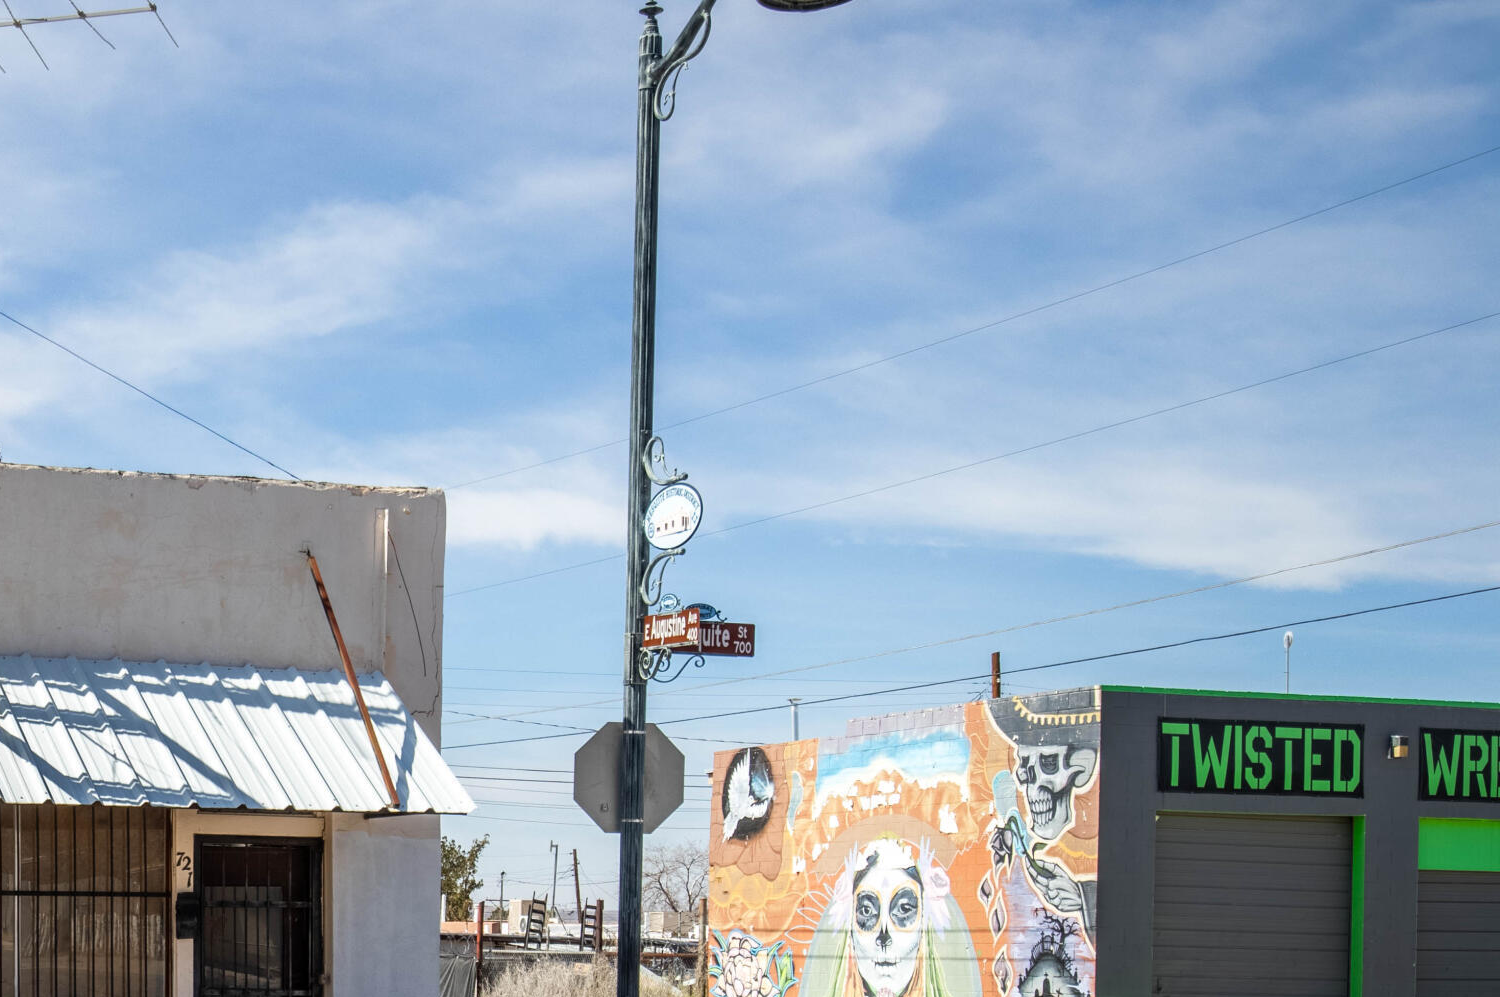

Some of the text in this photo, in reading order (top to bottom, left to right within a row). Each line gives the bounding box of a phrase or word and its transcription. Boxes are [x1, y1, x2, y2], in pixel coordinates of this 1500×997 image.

[645, 624, 650, 640] E
[651, 614, 686, 645] Augustine
[688, 611, 698, 624] Ave
[687, 627, 698, 641] 400
[738, 626, 748, 639] St
[734, 641, 752, 654] 700
[1162, 722, 1361, 792] TWISTED
